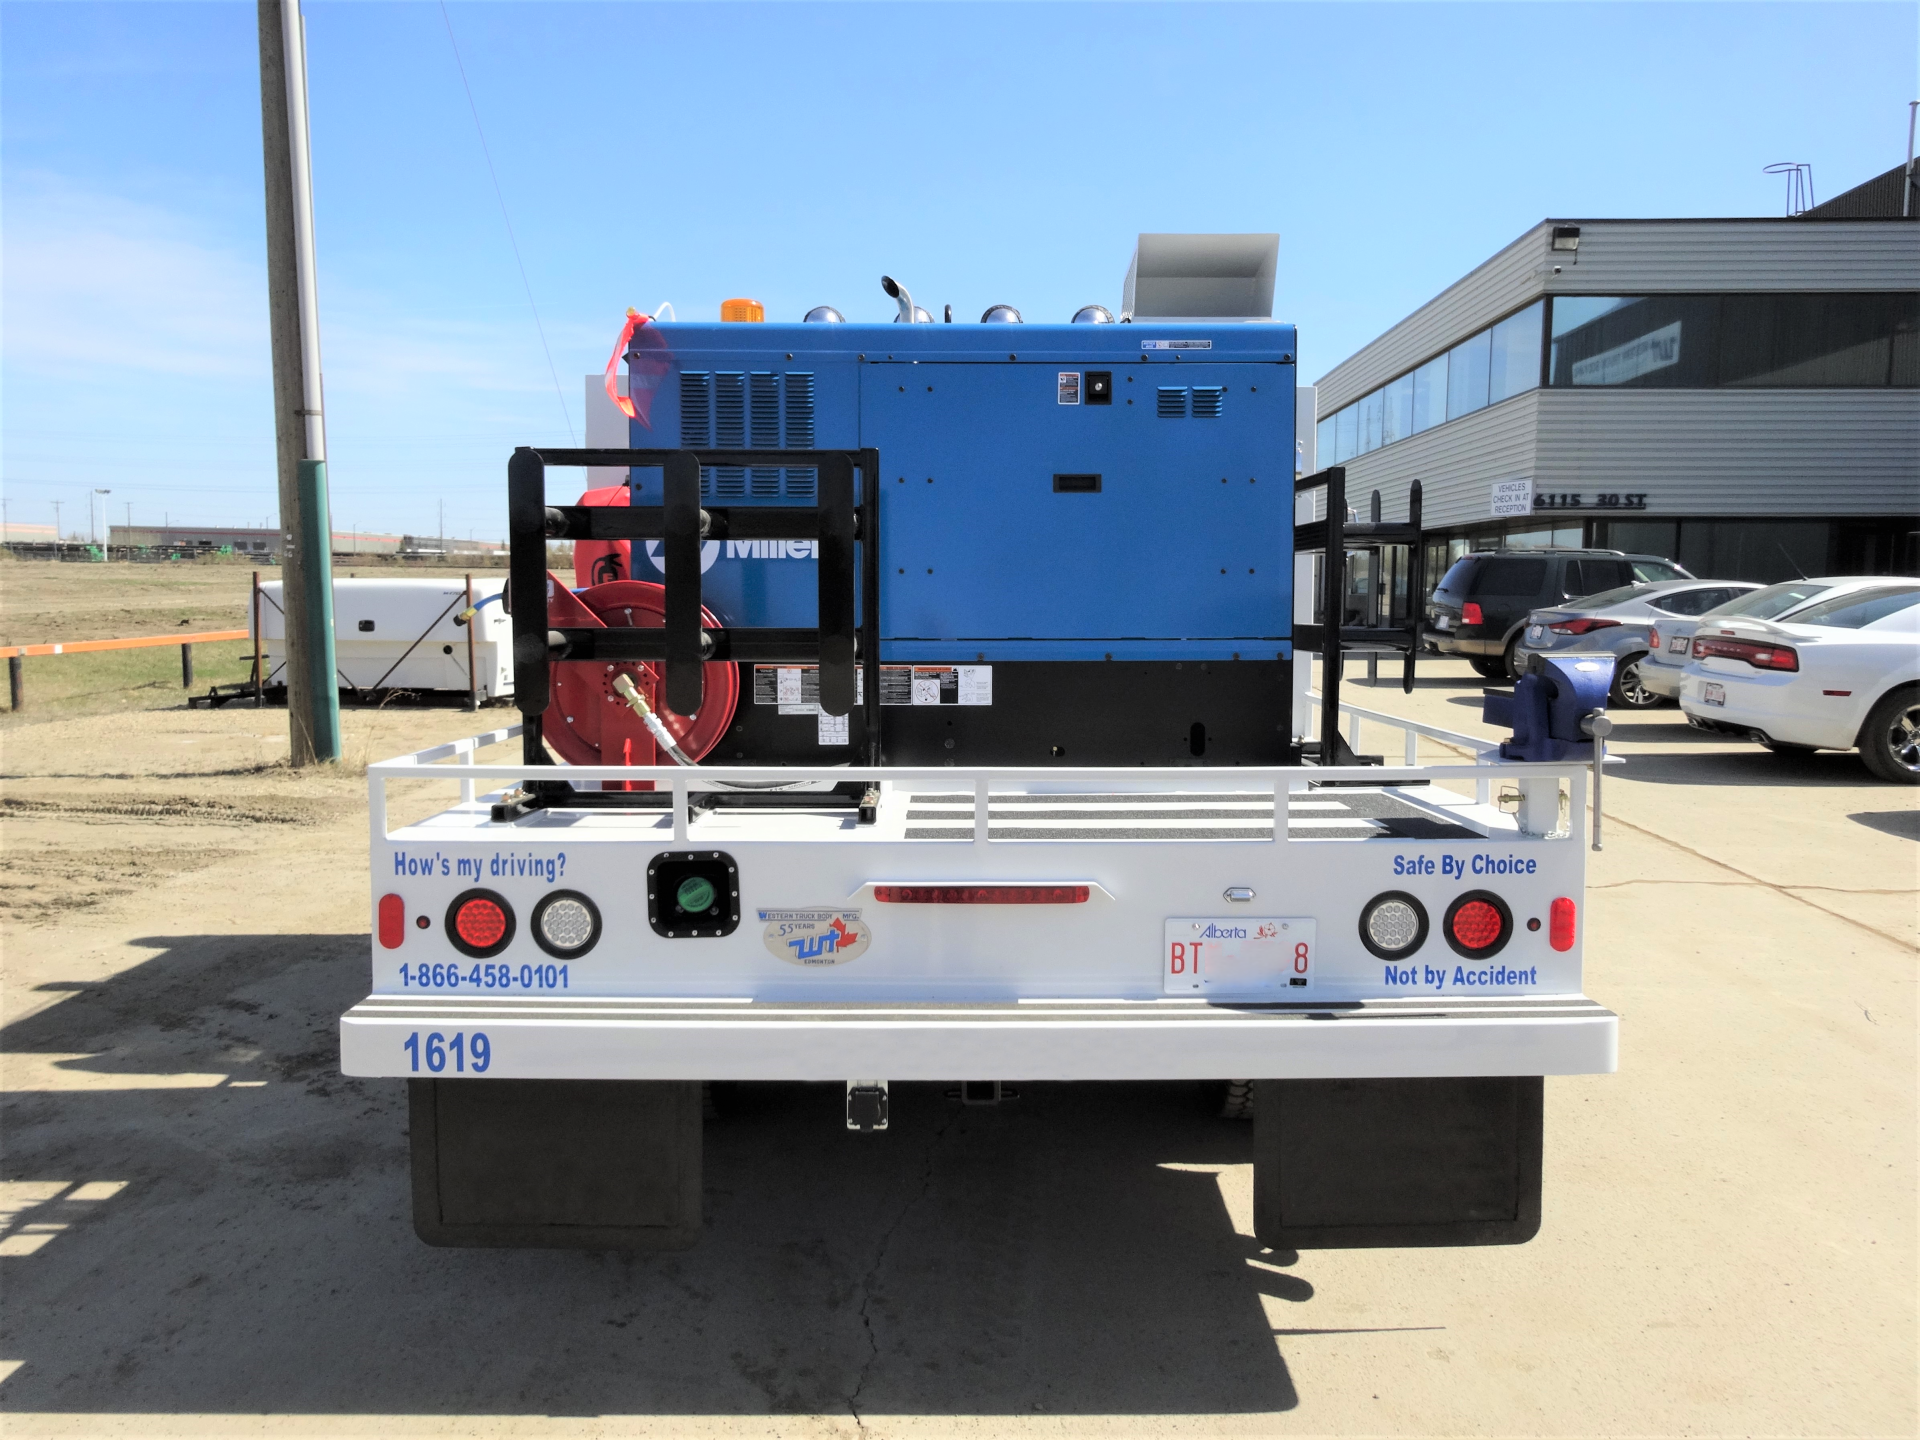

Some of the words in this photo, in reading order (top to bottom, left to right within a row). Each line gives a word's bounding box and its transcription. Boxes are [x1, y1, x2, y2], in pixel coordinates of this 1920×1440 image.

[1498, 482, 1526, 493] VEHICLES
[1492, 496, 1513, 504] CHECK
[1514, 494, 1521, 502] IN
[1522, 492, 1530, 502] AT
[1533, 493, 1581, 507] 6115
[1597, 493, 1620, 507] 30
[1494, 503, 1527, 514] RECEPTION
[394, 851, 450, 876] How's
[457, 858, 483, 883] my
[490, 852, 567, 883] driving?
[1393, 854, 1436, 876] Safe
[1441, 854, 1466, 881] By
[1471, 853, 1537, 875] Choice
[758, 912, 794, 920] WESTERN
[778, 923, 794, 936] 55
[1199, 922, 1247, 939] Alberta
[399, 962, 569, 989] 1-866-458-0101
[1384, 964, 1418, 986] Not
[1424, 964, 1447, 990] by
[1452, 964, 1537, 986] Accident
[404, 1031, 491, 1073] 1619
